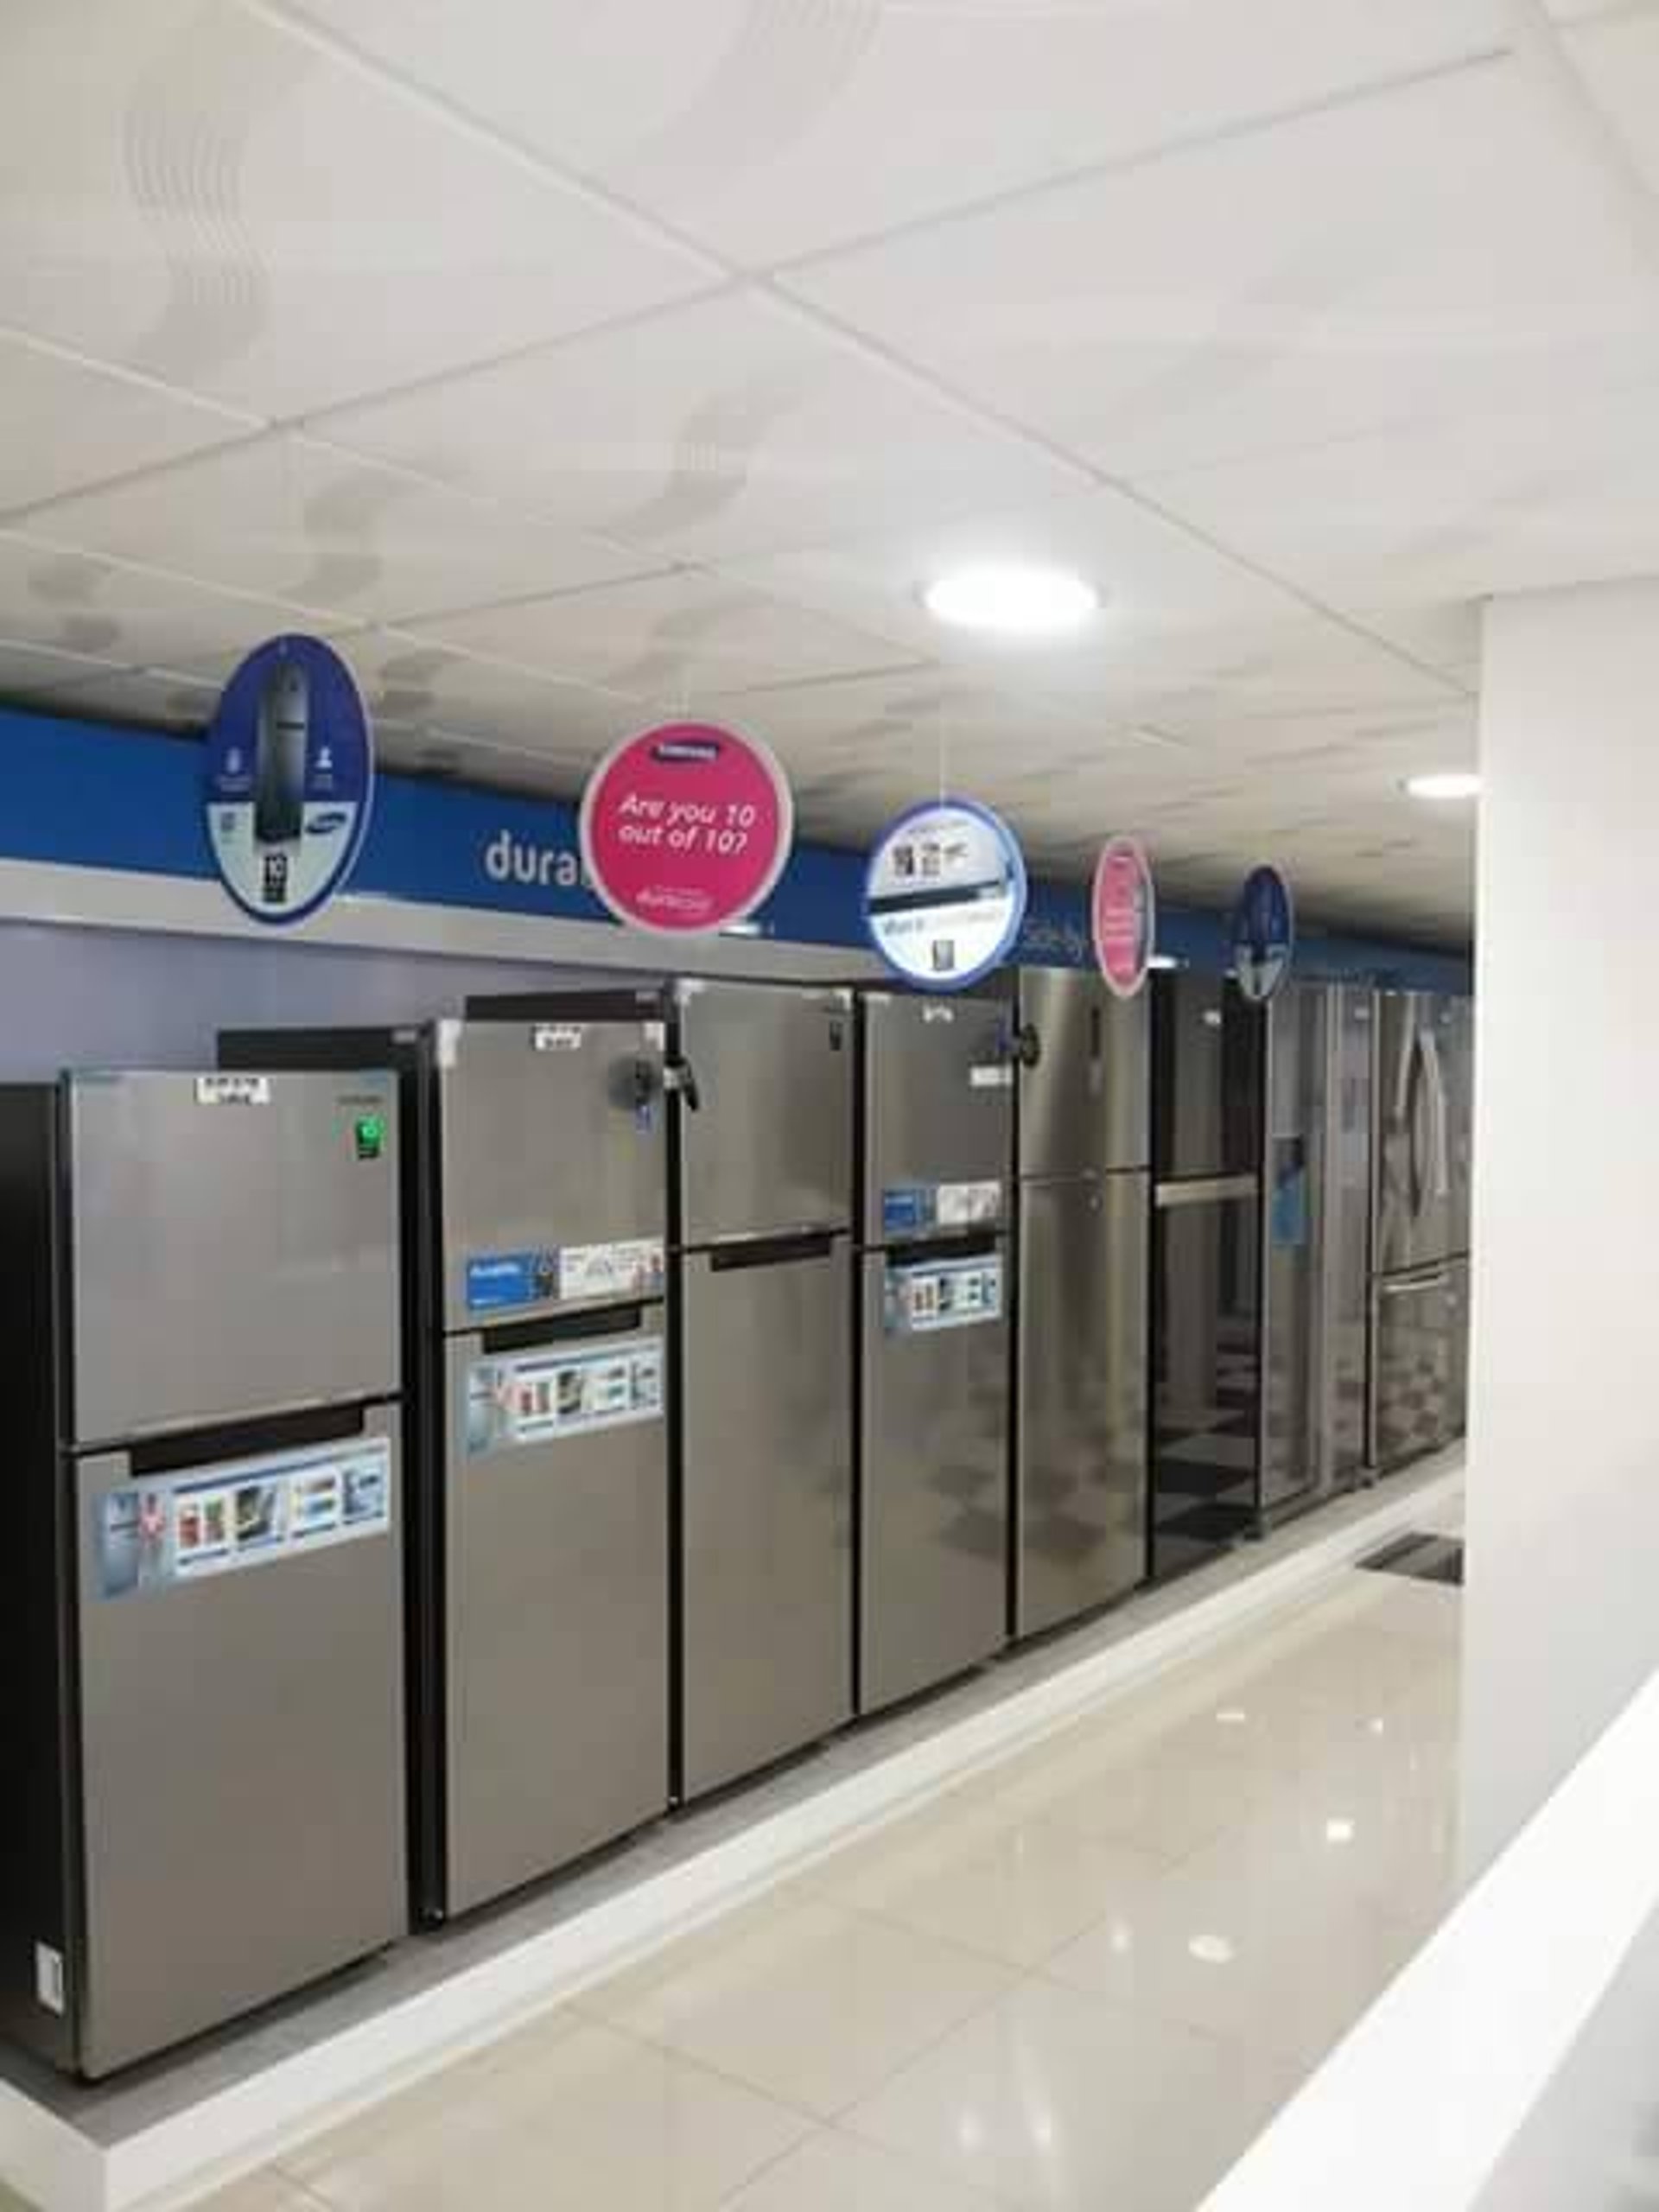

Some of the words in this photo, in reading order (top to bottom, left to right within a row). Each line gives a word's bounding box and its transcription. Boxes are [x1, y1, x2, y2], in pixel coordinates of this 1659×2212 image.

[619, 792, 664, 817] Are
[666, 802, 716, 826] you
[727, 804, 756, 828] 10
[486, 829, 590, 886] dura
[618, 825, 663, 846] out
[668, 826, 697, 850] of
[705, 830, 748, 855] 10?
